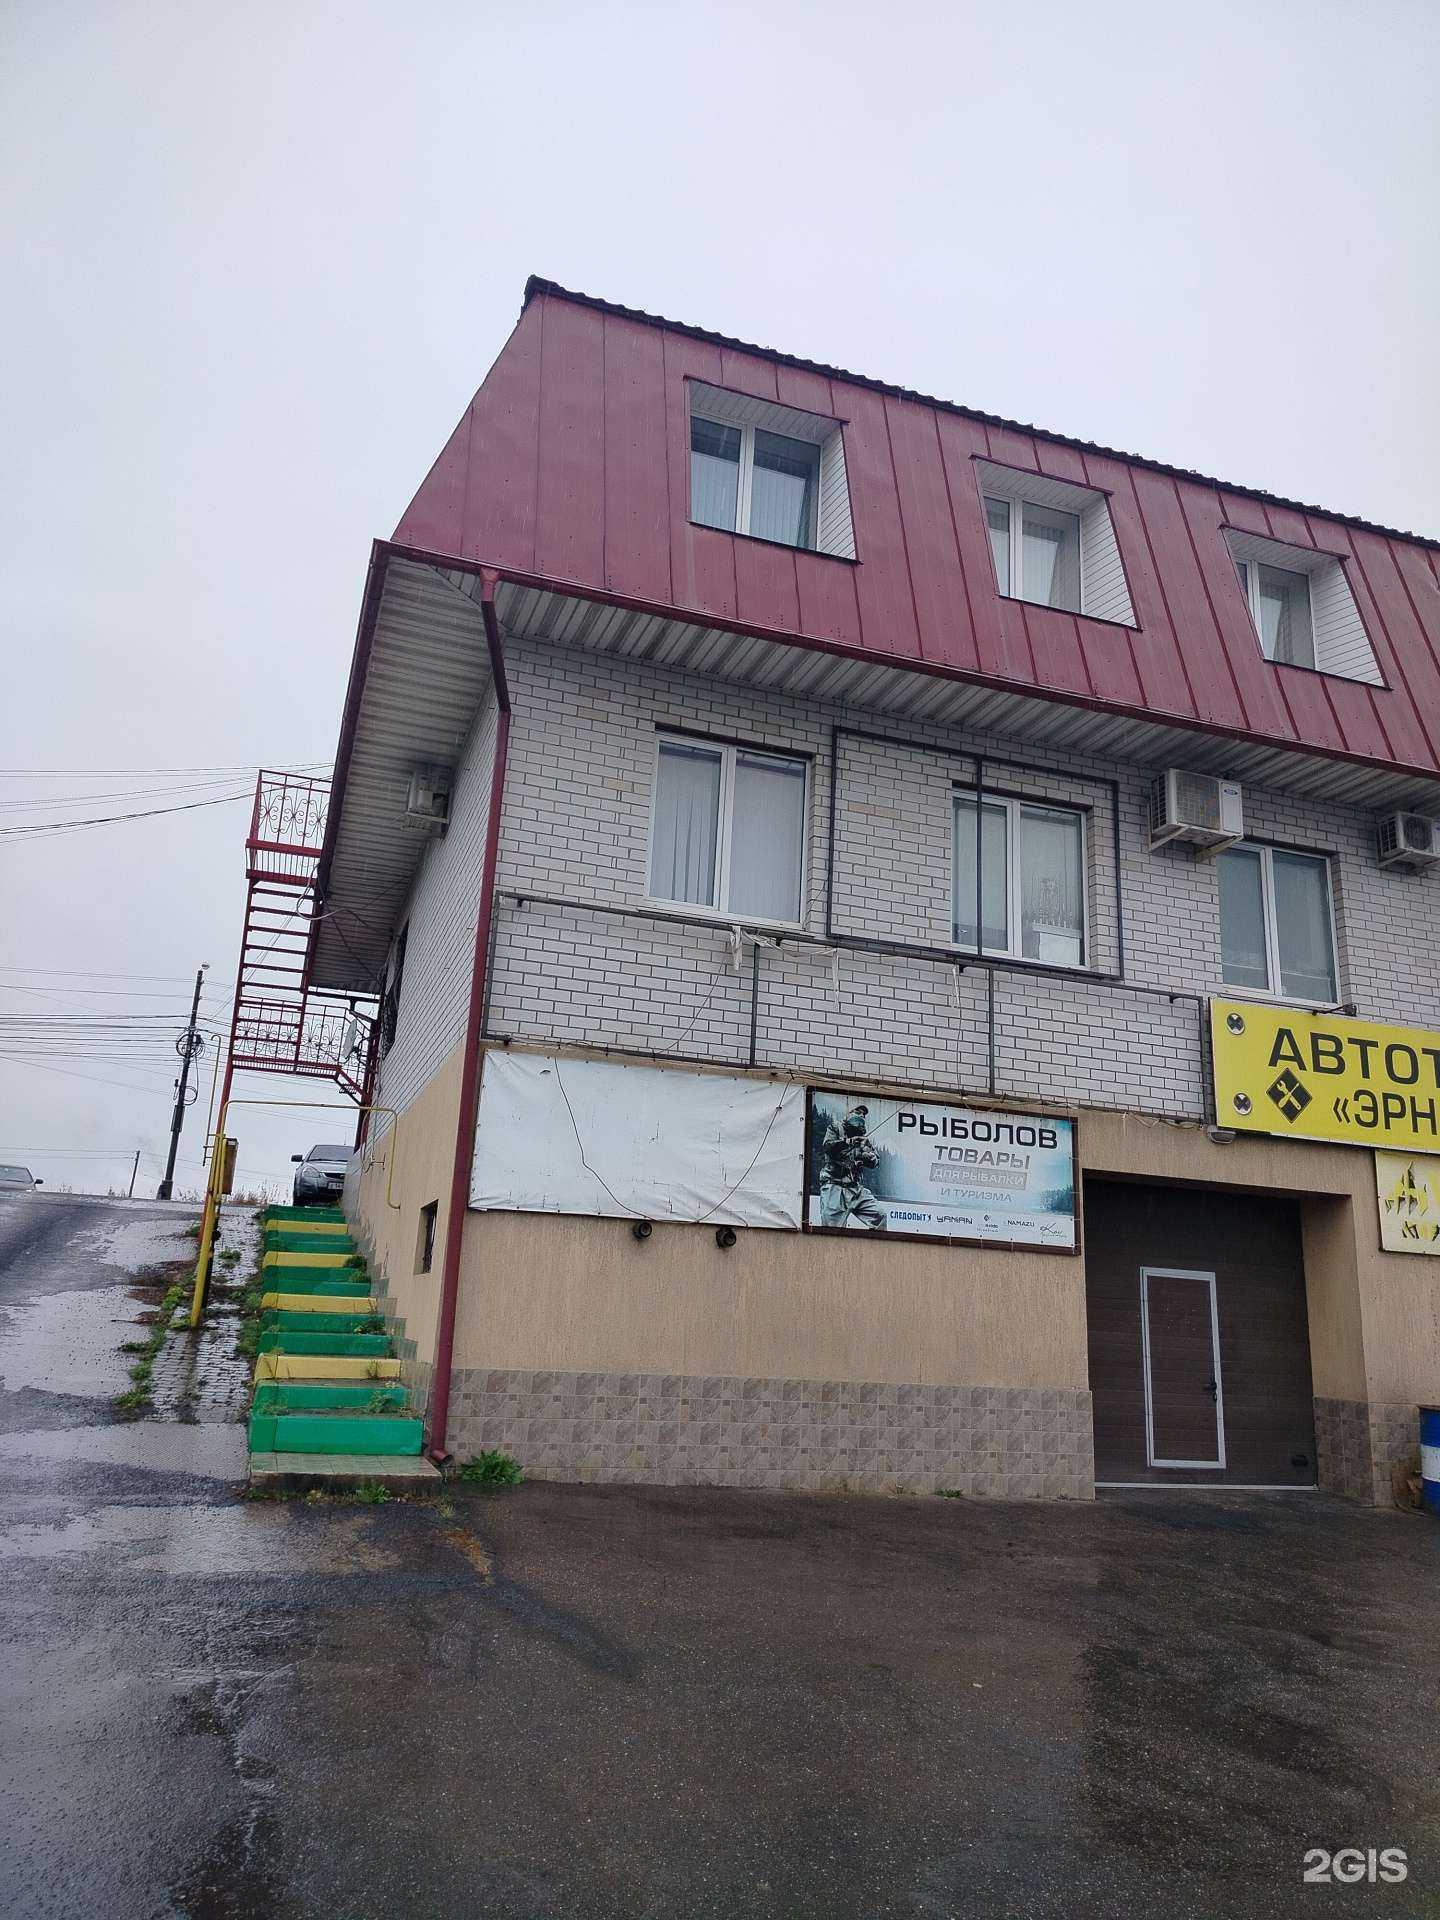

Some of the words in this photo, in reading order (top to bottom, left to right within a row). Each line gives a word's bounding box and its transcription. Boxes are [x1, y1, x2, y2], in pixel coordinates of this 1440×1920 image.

[898, 1112, 1058, 1149] РЫБОЛОВ
[934, 1145, 1030, 1170] ТОВАРЫ
[933, 1168, 960, 1180] ДЛЯ
[962, 1170, 1025, 1185] РЫБАЛКИ
[941, 1187, 951, 1196] И
[953, 1188, 1012, 1202] ТУРИЗМА
